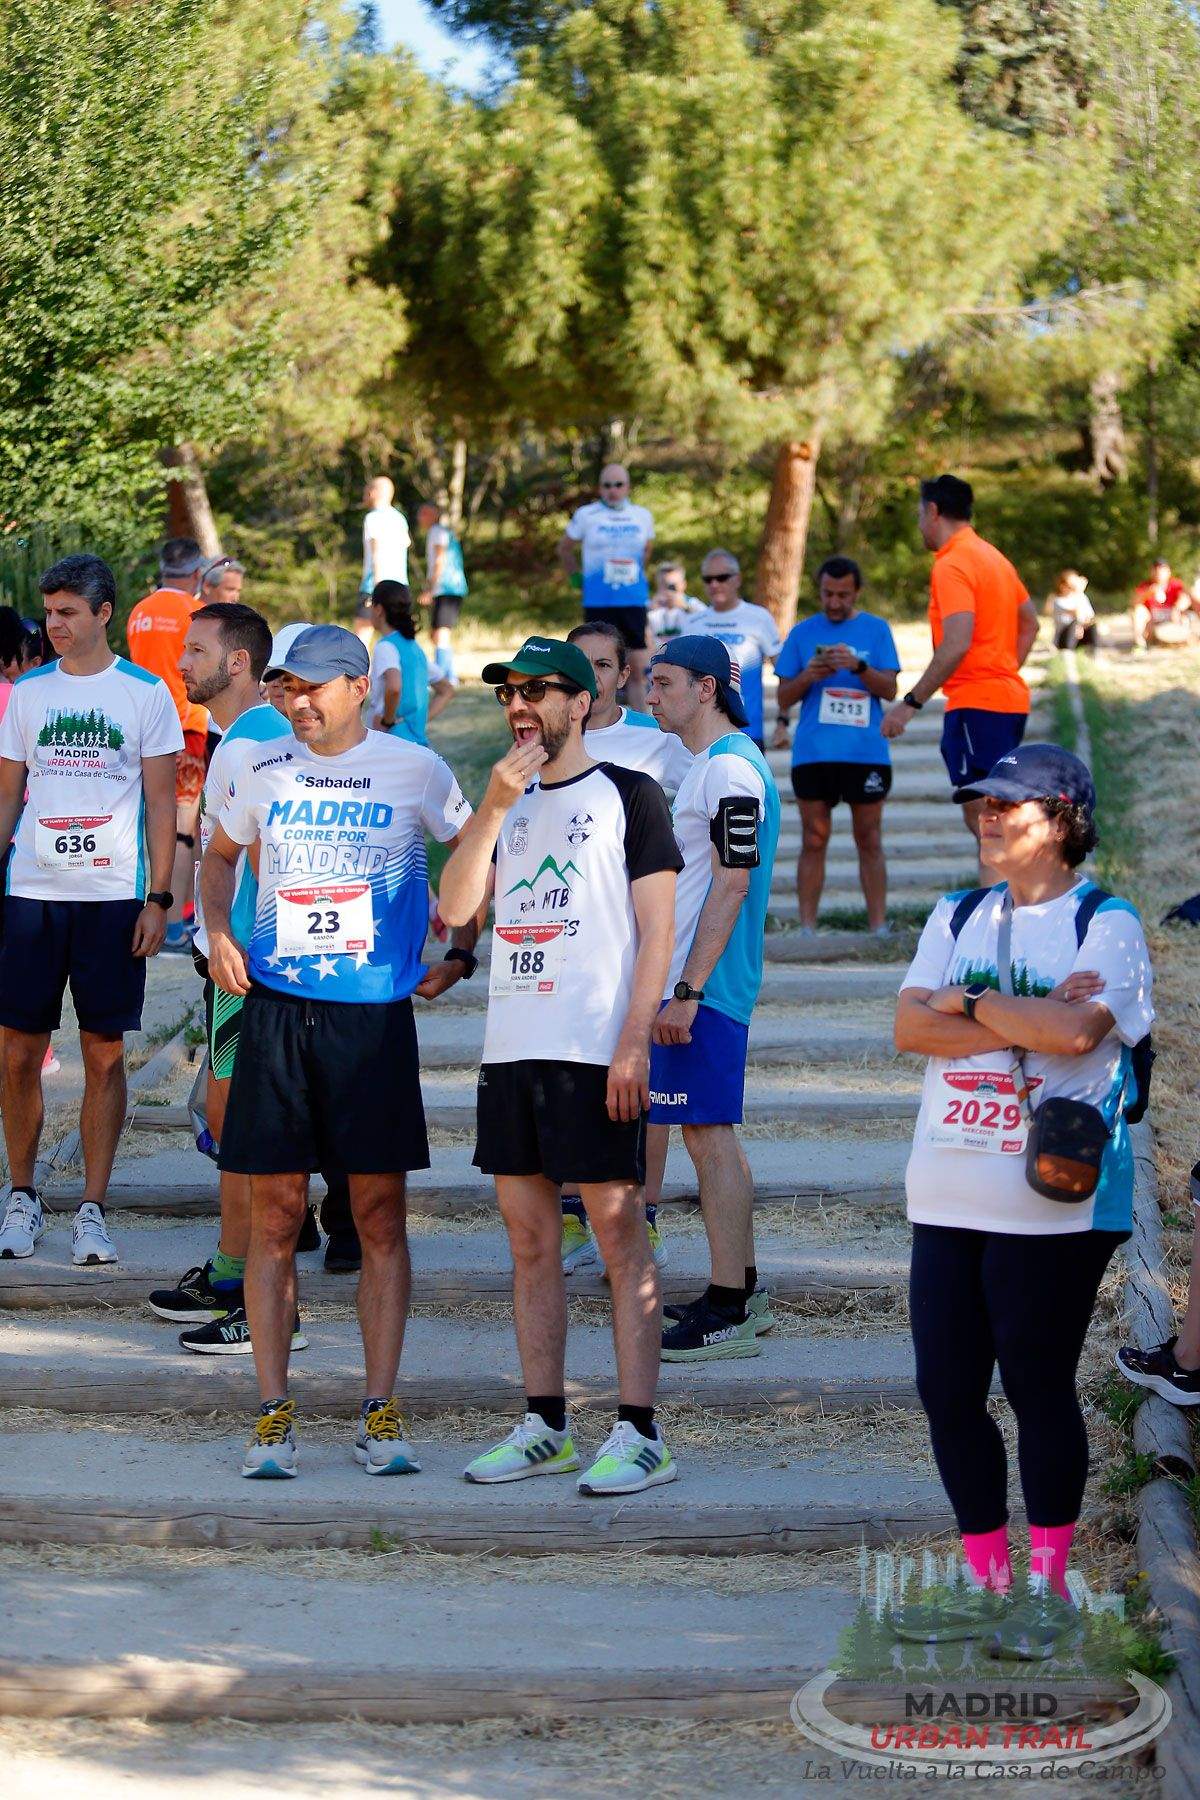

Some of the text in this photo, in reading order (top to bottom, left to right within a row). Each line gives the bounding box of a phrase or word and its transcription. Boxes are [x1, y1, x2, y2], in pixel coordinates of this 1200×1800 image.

[830, 702, 863, 716] 1213
[54, 748, 100, 758] MADRID
[47, 758, 108, 769] URBAN TRAIL
[304, 776, 371, 789] Sabadell
[266, 800, 394, 828] MADRID
[55, 834, 96, 854] 636
[283, 829, 367, 842] CORRE POR
[267, 844, 389, 876] MADRID
[542, 888, 569, 909] MTB
[308, 911, 340, 934] 23
[510, 950, 544, 974] 188
[942, 1100, 1022, 1130] 2029
